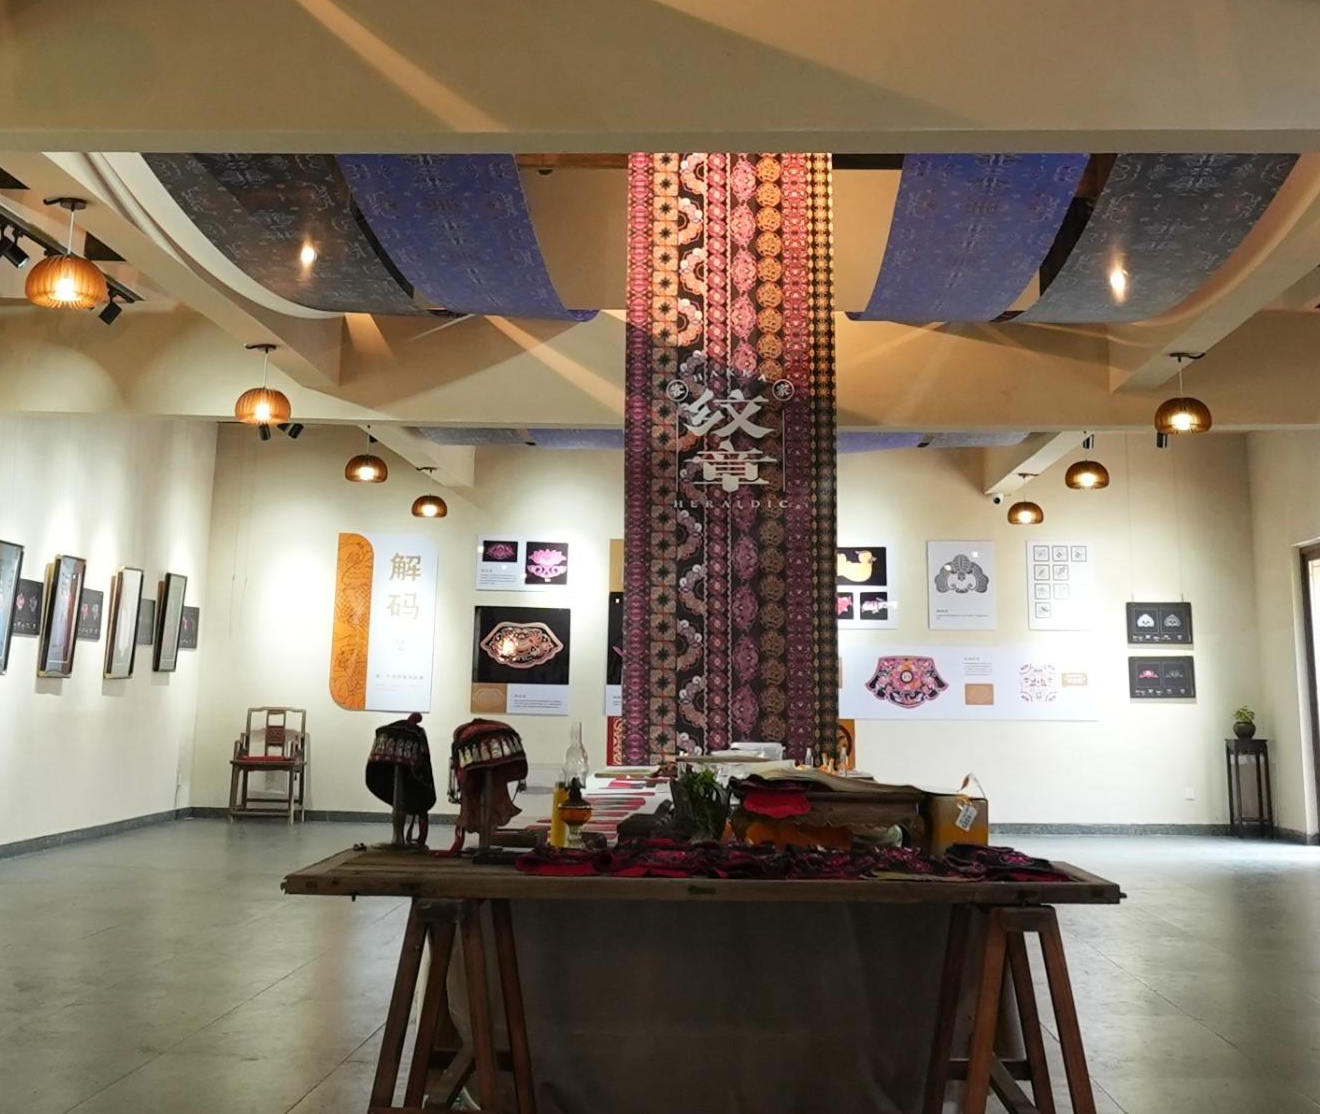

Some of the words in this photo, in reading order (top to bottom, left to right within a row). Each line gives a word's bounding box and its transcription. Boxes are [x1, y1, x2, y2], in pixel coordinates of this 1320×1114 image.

[693, 368, 767, 383] HAKKA
[683, 388, 776, 493] 纹章
[673, 499, 789, 509] HERALDIC
[386, 552, 422, 621] 解码
